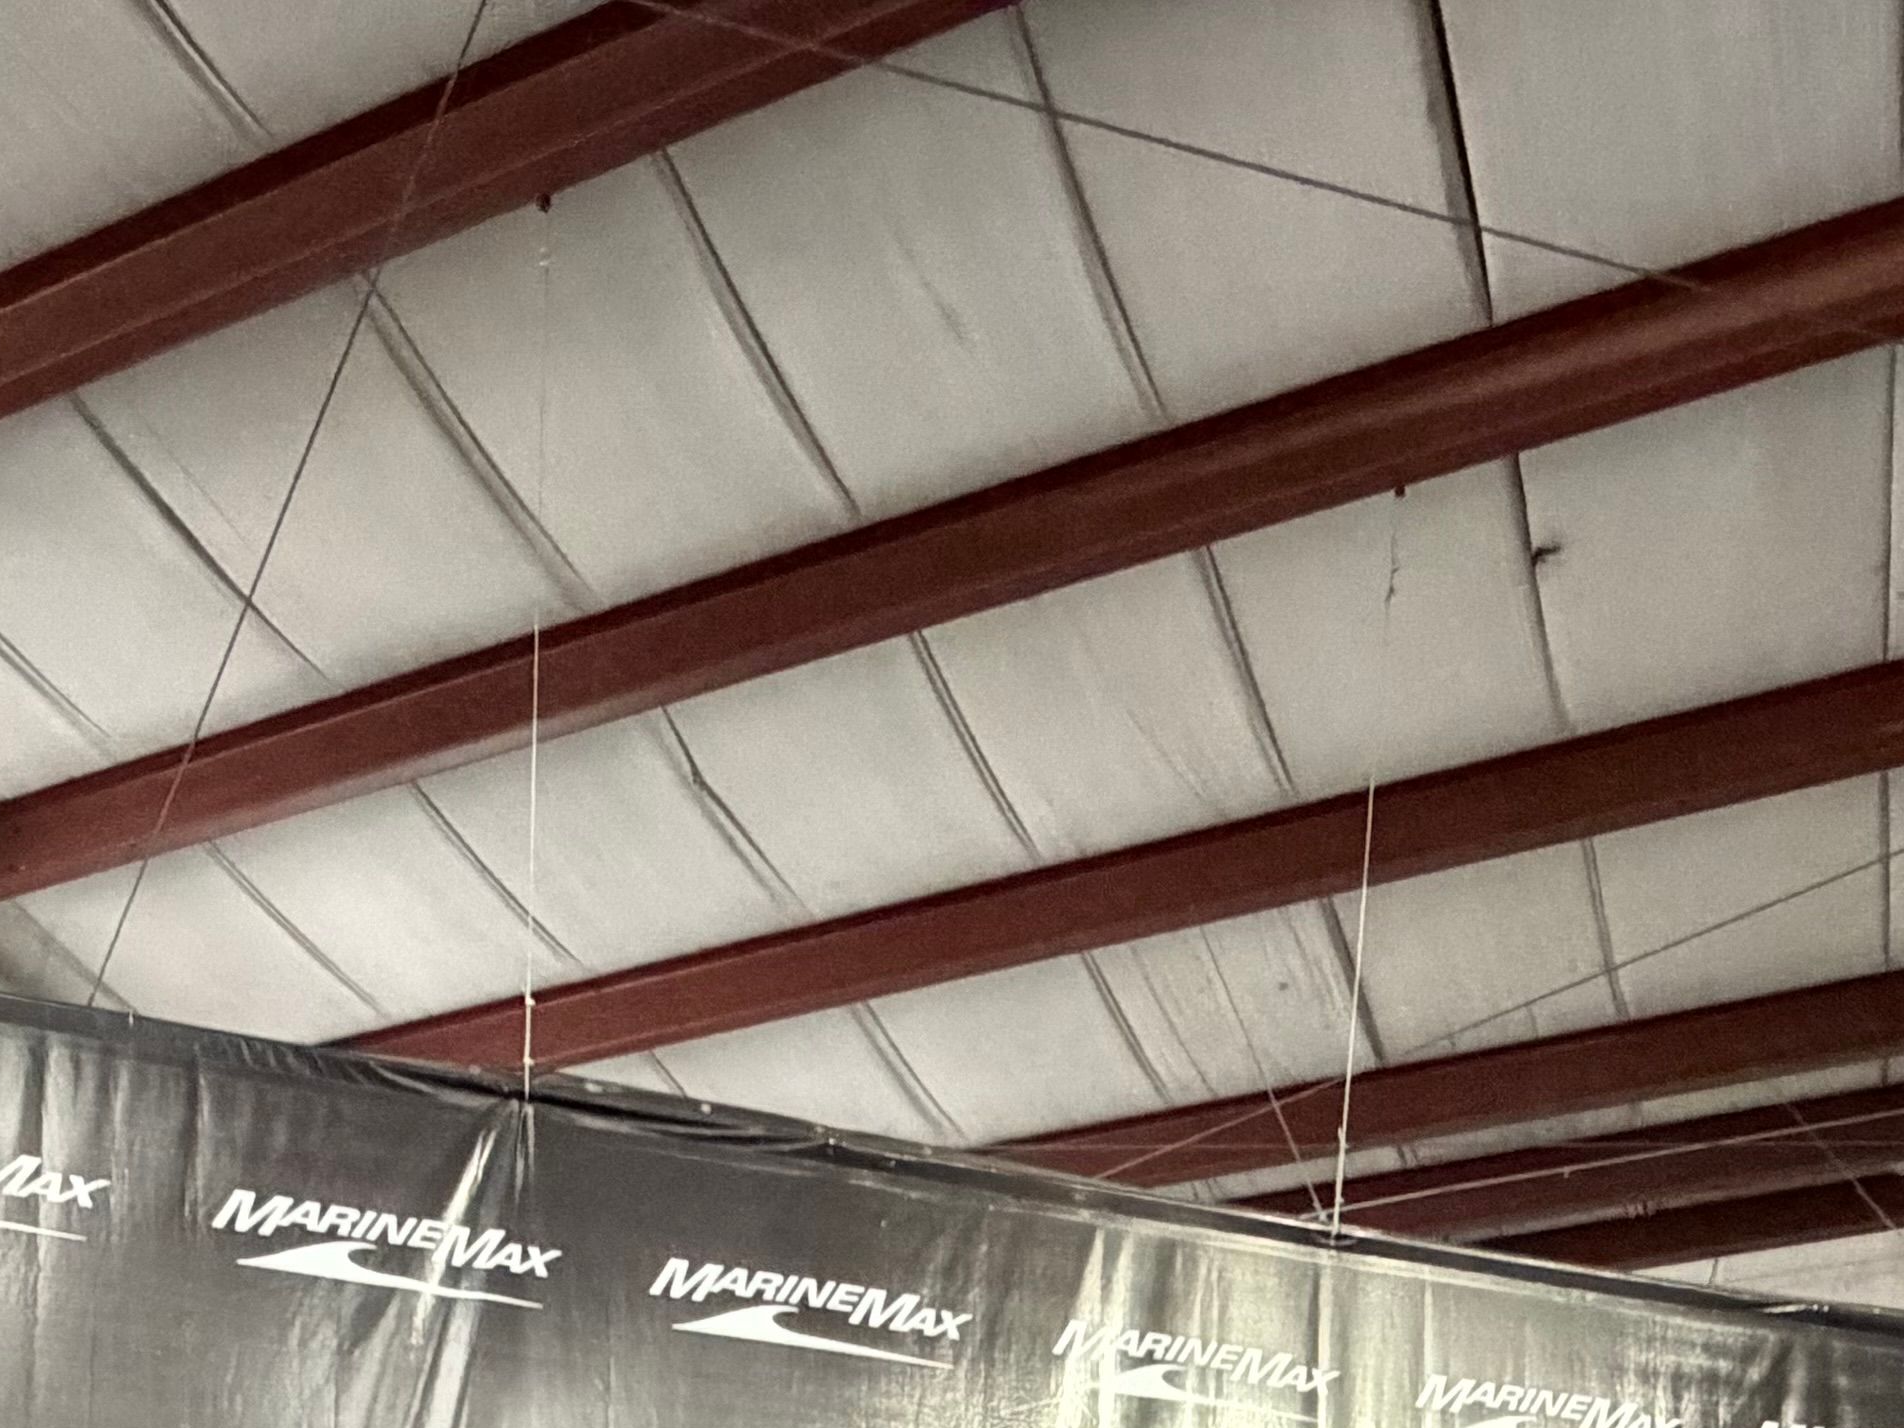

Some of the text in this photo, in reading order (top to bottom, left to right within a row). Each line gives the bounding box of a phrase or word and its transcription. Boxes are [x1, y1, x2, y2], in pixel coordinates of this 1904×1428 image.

[211, 1188, 563, 1278] MARINEMAX
[649, 1257, 973, 1342] MARINEMAX
[1052, 1318, 1340, 1396] MARINEMAX
